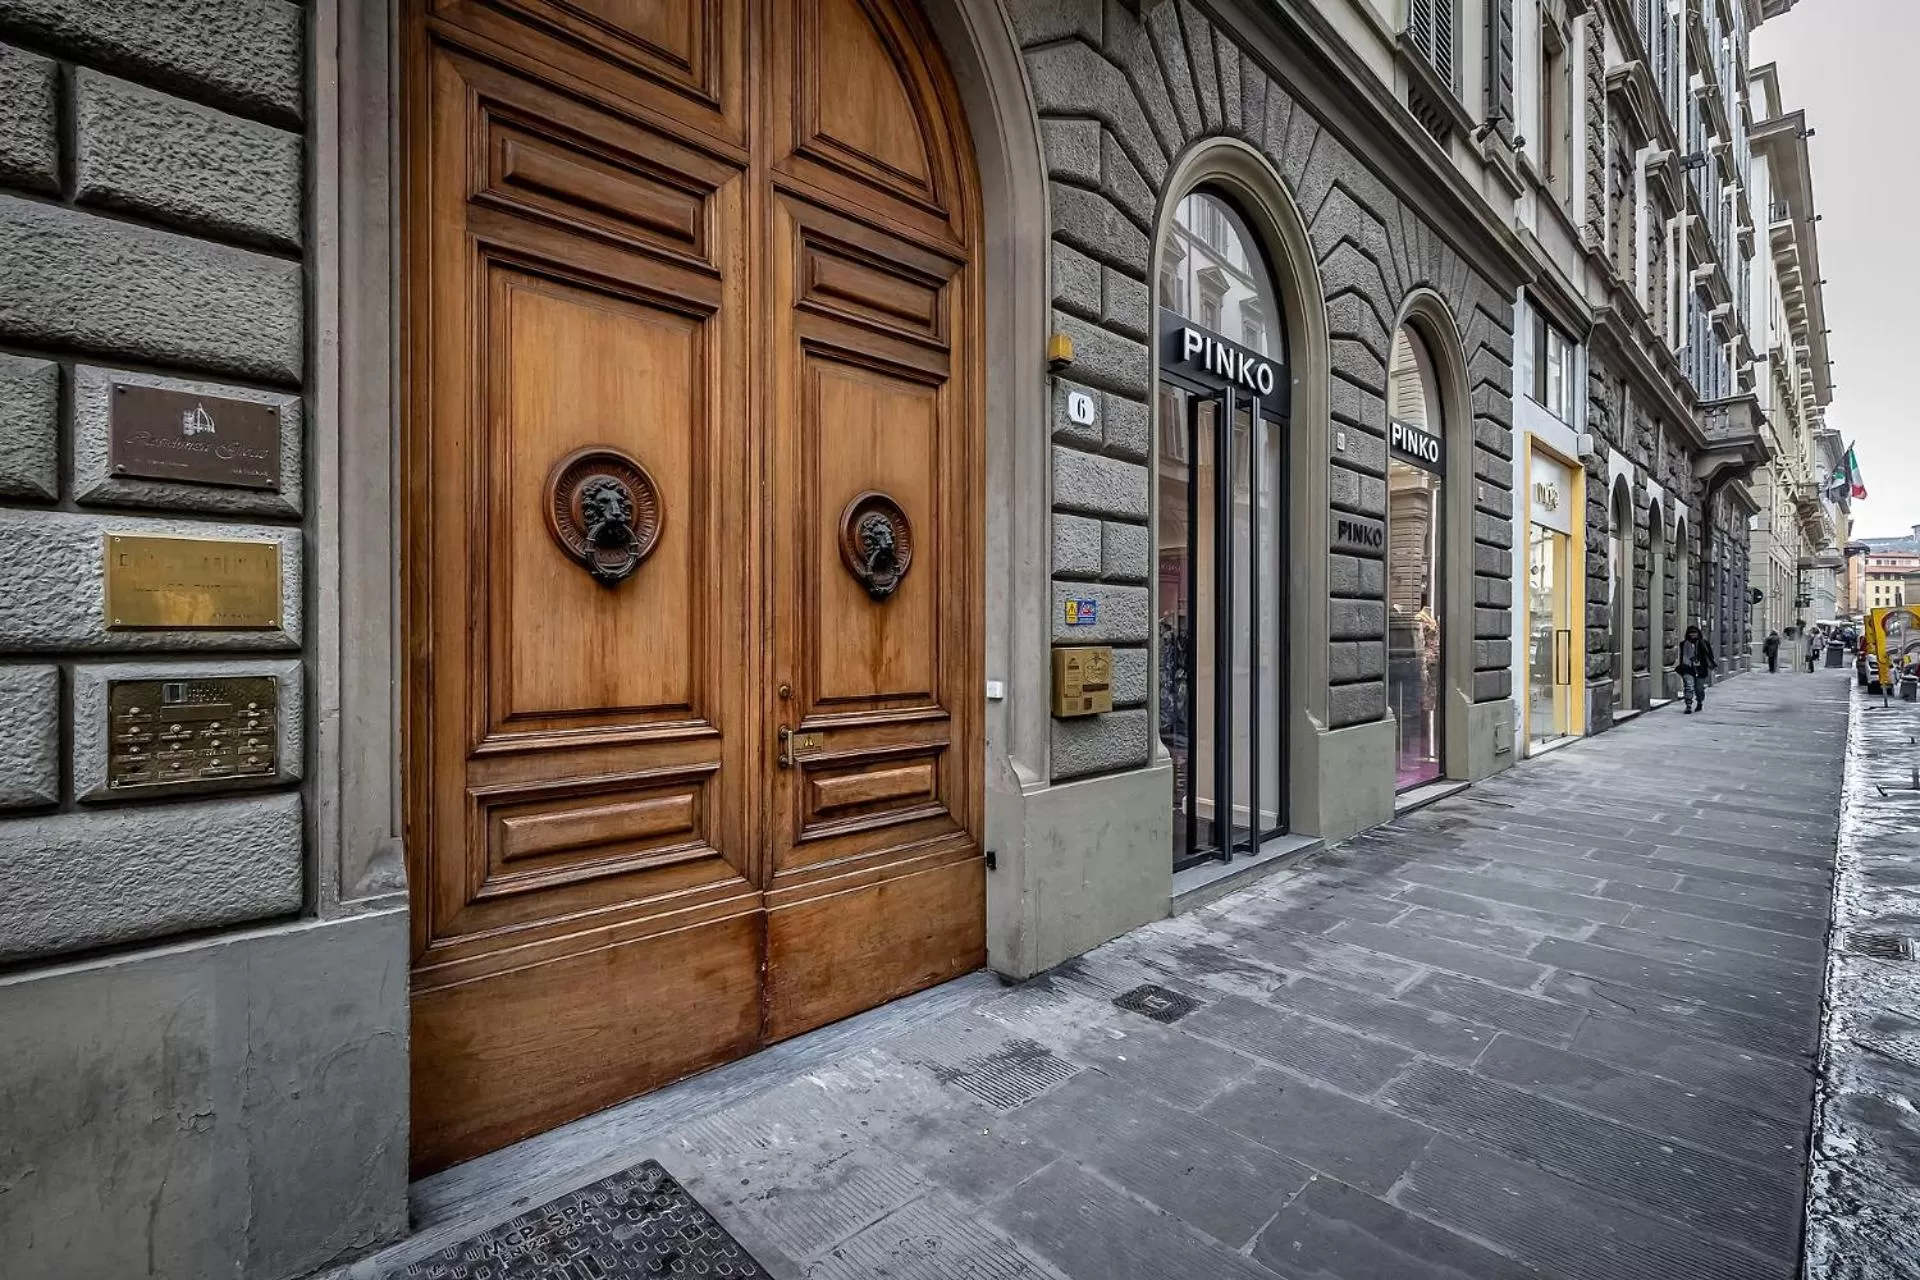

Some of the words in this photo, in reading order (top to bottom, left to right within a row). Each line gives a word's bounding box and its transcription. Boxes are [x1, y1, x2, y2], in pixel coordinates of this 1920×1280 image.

[1183, 327, 1274, 395] PINKO
[1077, 397, 1087, 419] 6
[1391, 422, 1439, 462] PINKO
[1776, 454, 1799, 530] SAVO
[1338, 520, 1382, 547] PINKO
[483, 1225, 535, 1260] MCP
[547, 1200, 598, 1228] SPA
